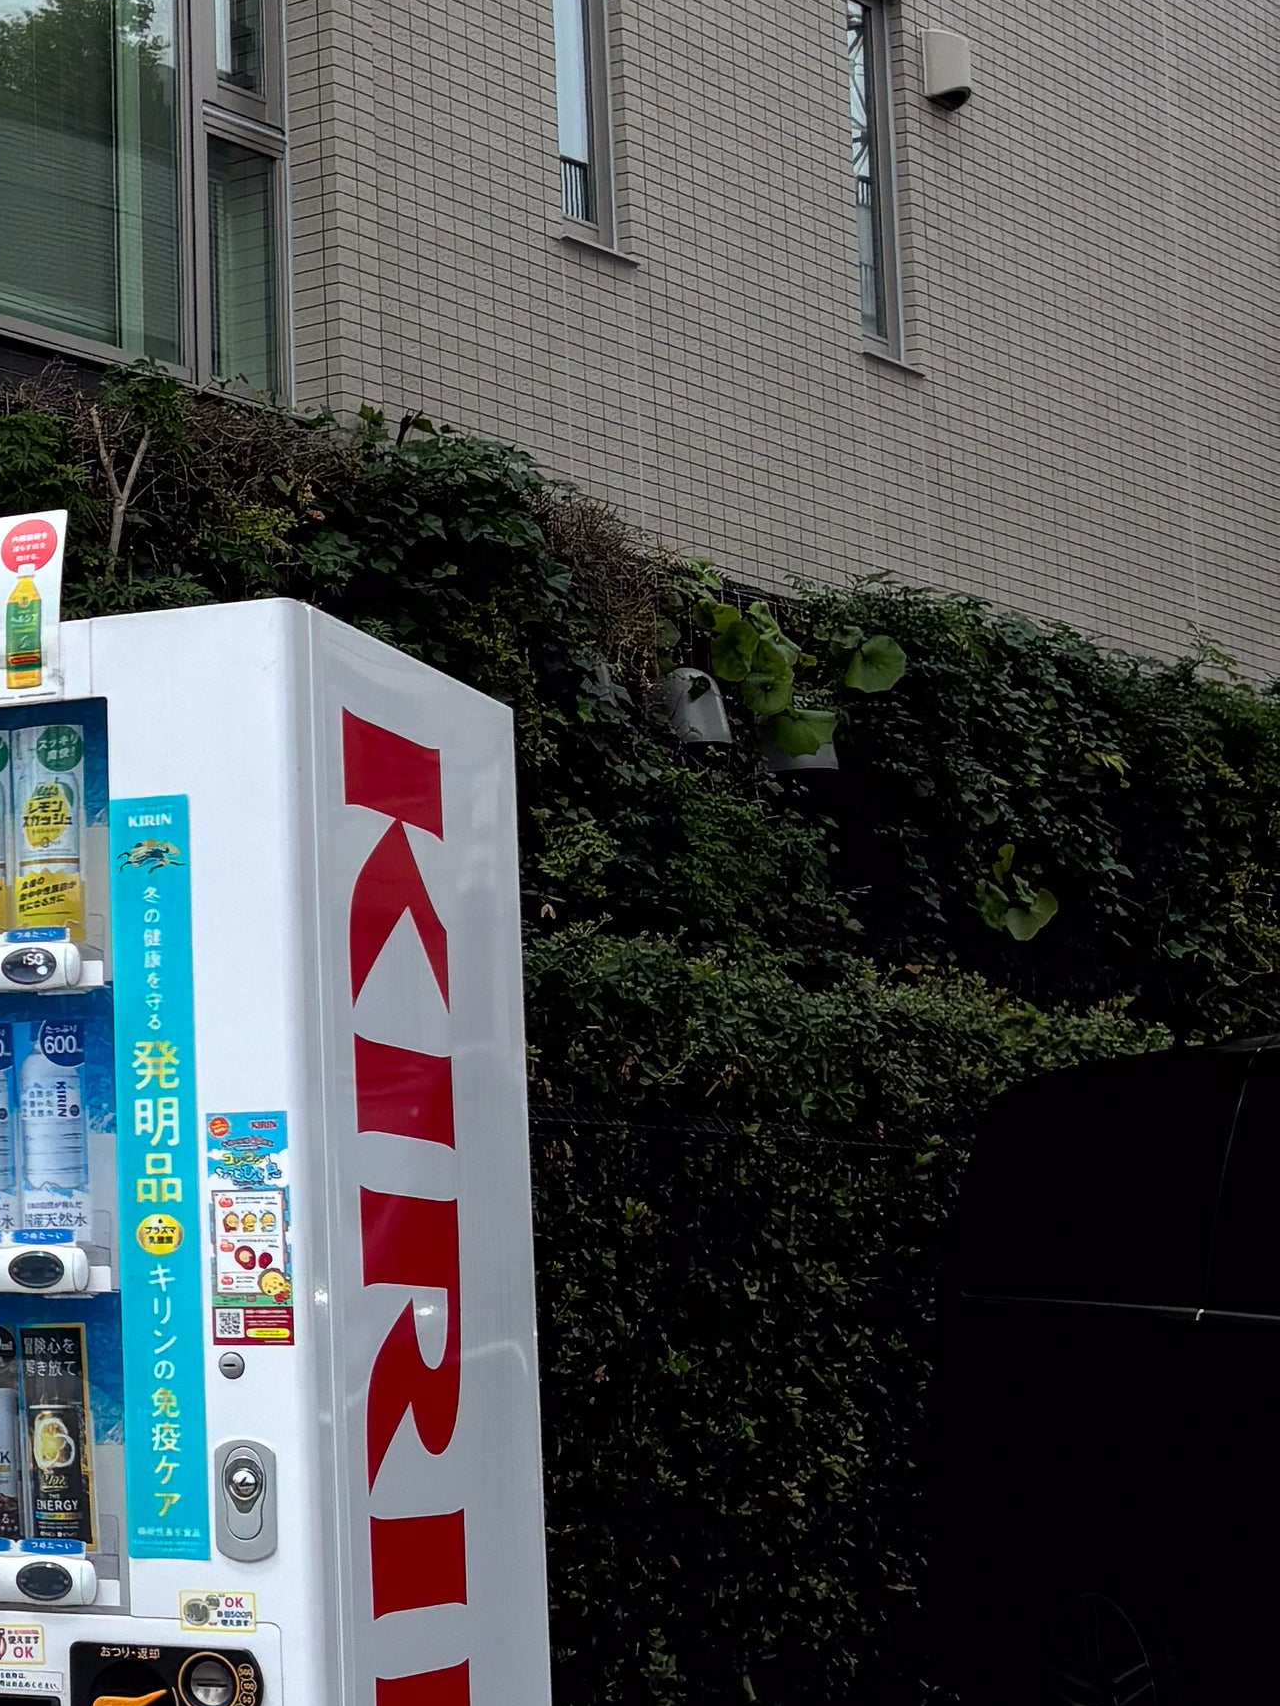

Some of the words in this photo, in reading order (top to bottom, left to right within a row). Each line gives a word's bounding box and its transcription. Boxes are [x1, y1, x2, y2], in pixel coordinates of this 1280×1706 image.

[37, 733, 78, 751] スッキリ
[28, 800, 63, 813] レモン
[23, 815, 72, 827] スカッシュ
[127, 813, 173, 828] KIRIN
[142, 886, 162, 1030] 冬の健康を守る
[44, 1035, 77, 1054] 600
[57, 1081, 68, 1118] KIRIN
[132, 1041, 183, 1203] 発明品
[149, 1264, 182, 1518] キリンの免疫ケア
[37, 1499, 78, 1511] ENERGY
[224, 1597, 244, 1609] OK
[13, 1647, 34, 1659] OK
